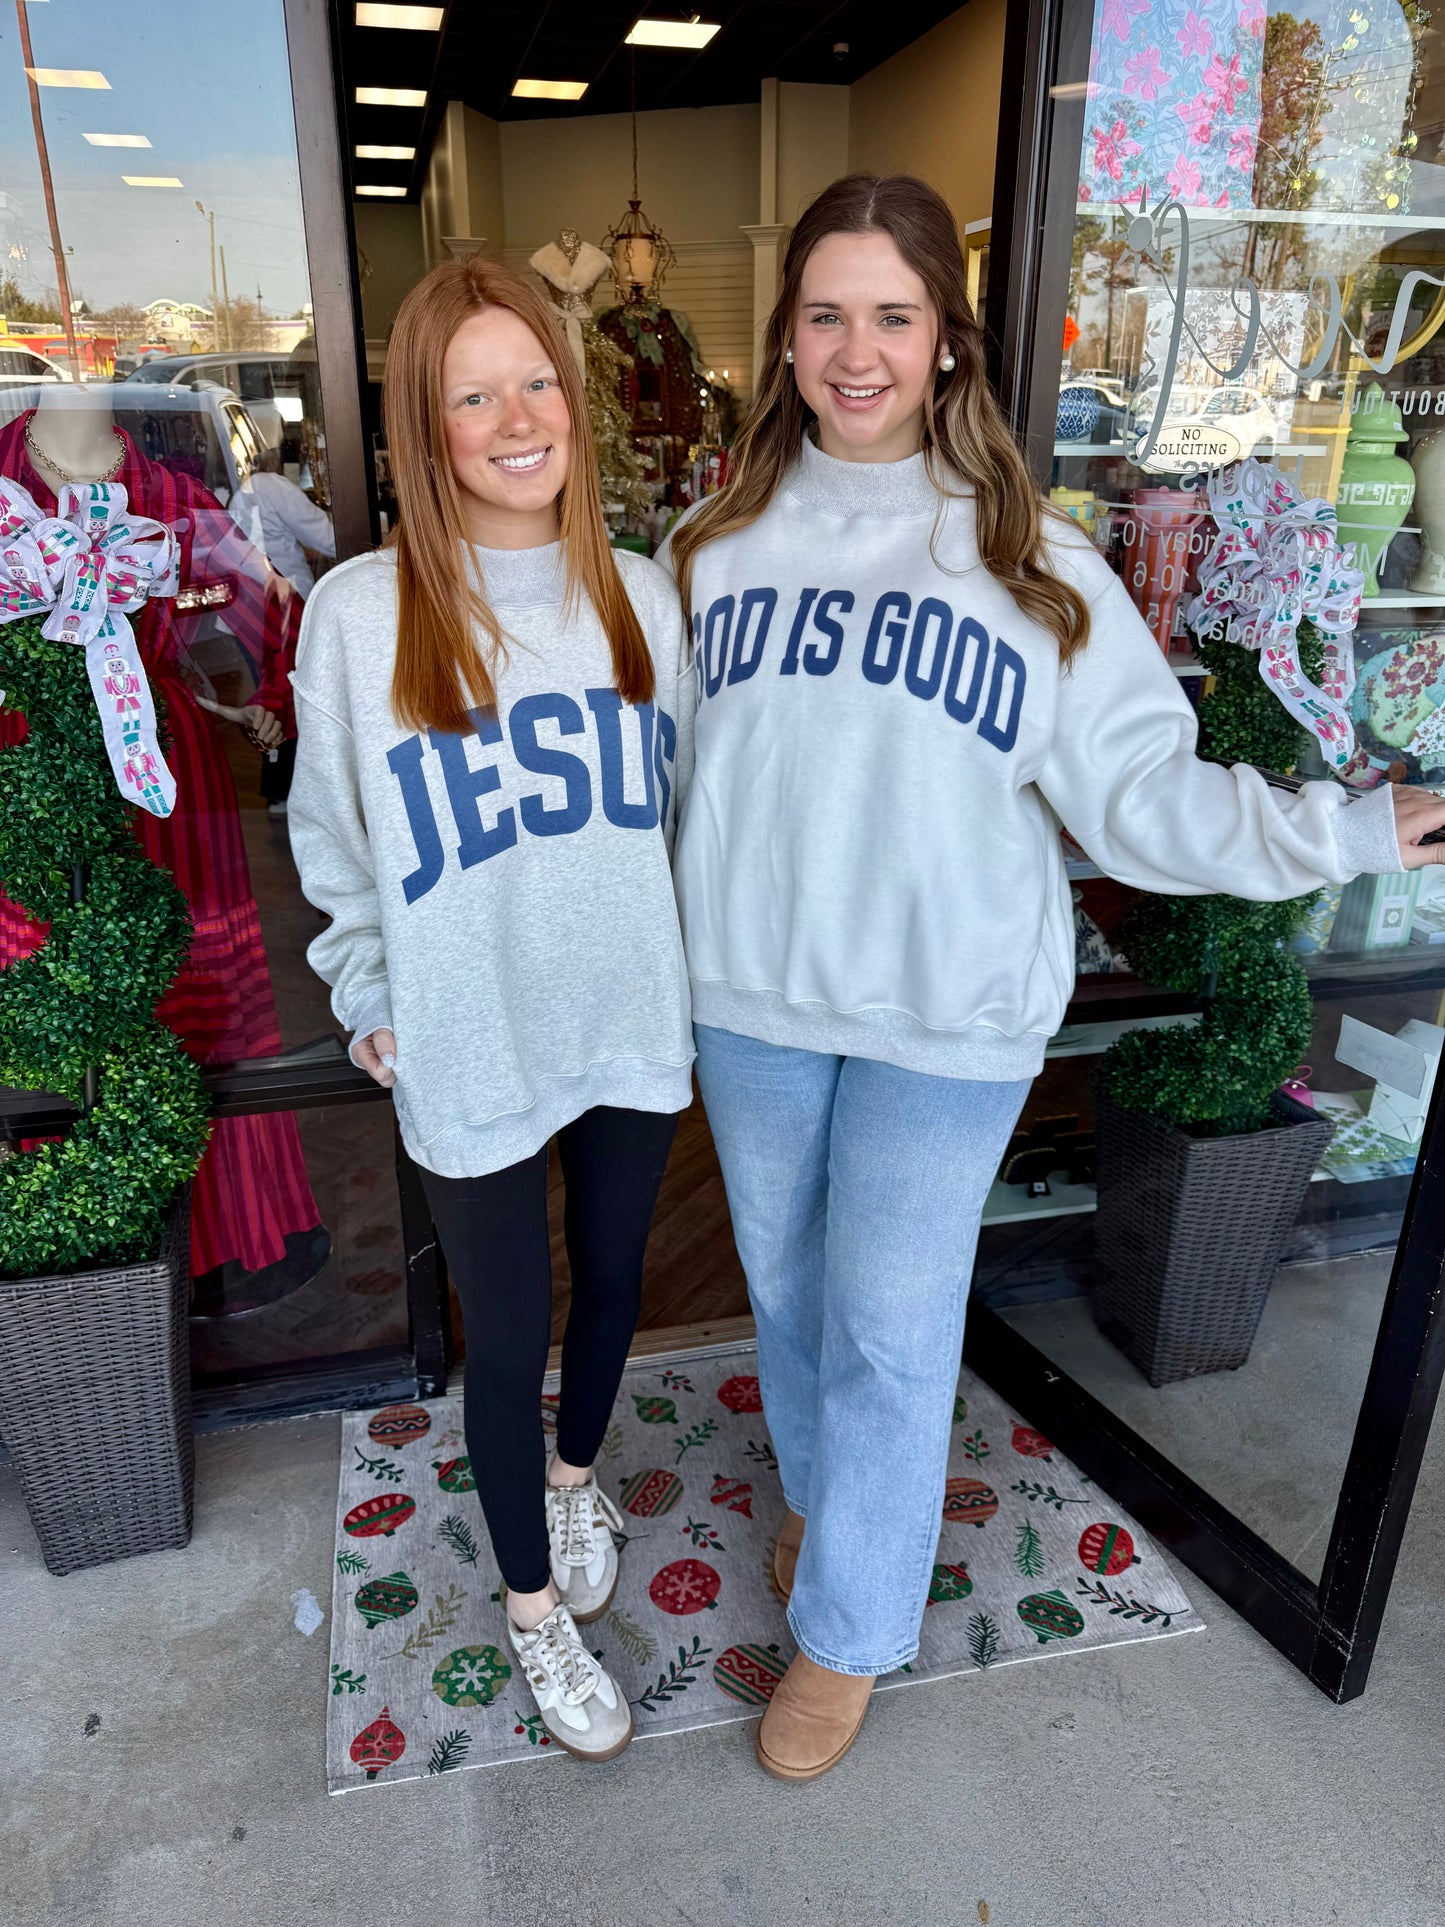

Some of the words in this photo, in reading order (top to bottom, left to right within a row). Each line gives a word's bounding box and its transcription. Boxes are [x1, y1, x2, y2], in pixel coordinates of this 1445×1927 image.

[1181, 428, 1201, 441] NO
[1150, 443, 1228, 455] SOLICITING
[779, 587, 855, 677] IS
[861, 590, 1027, 753] GOOD
